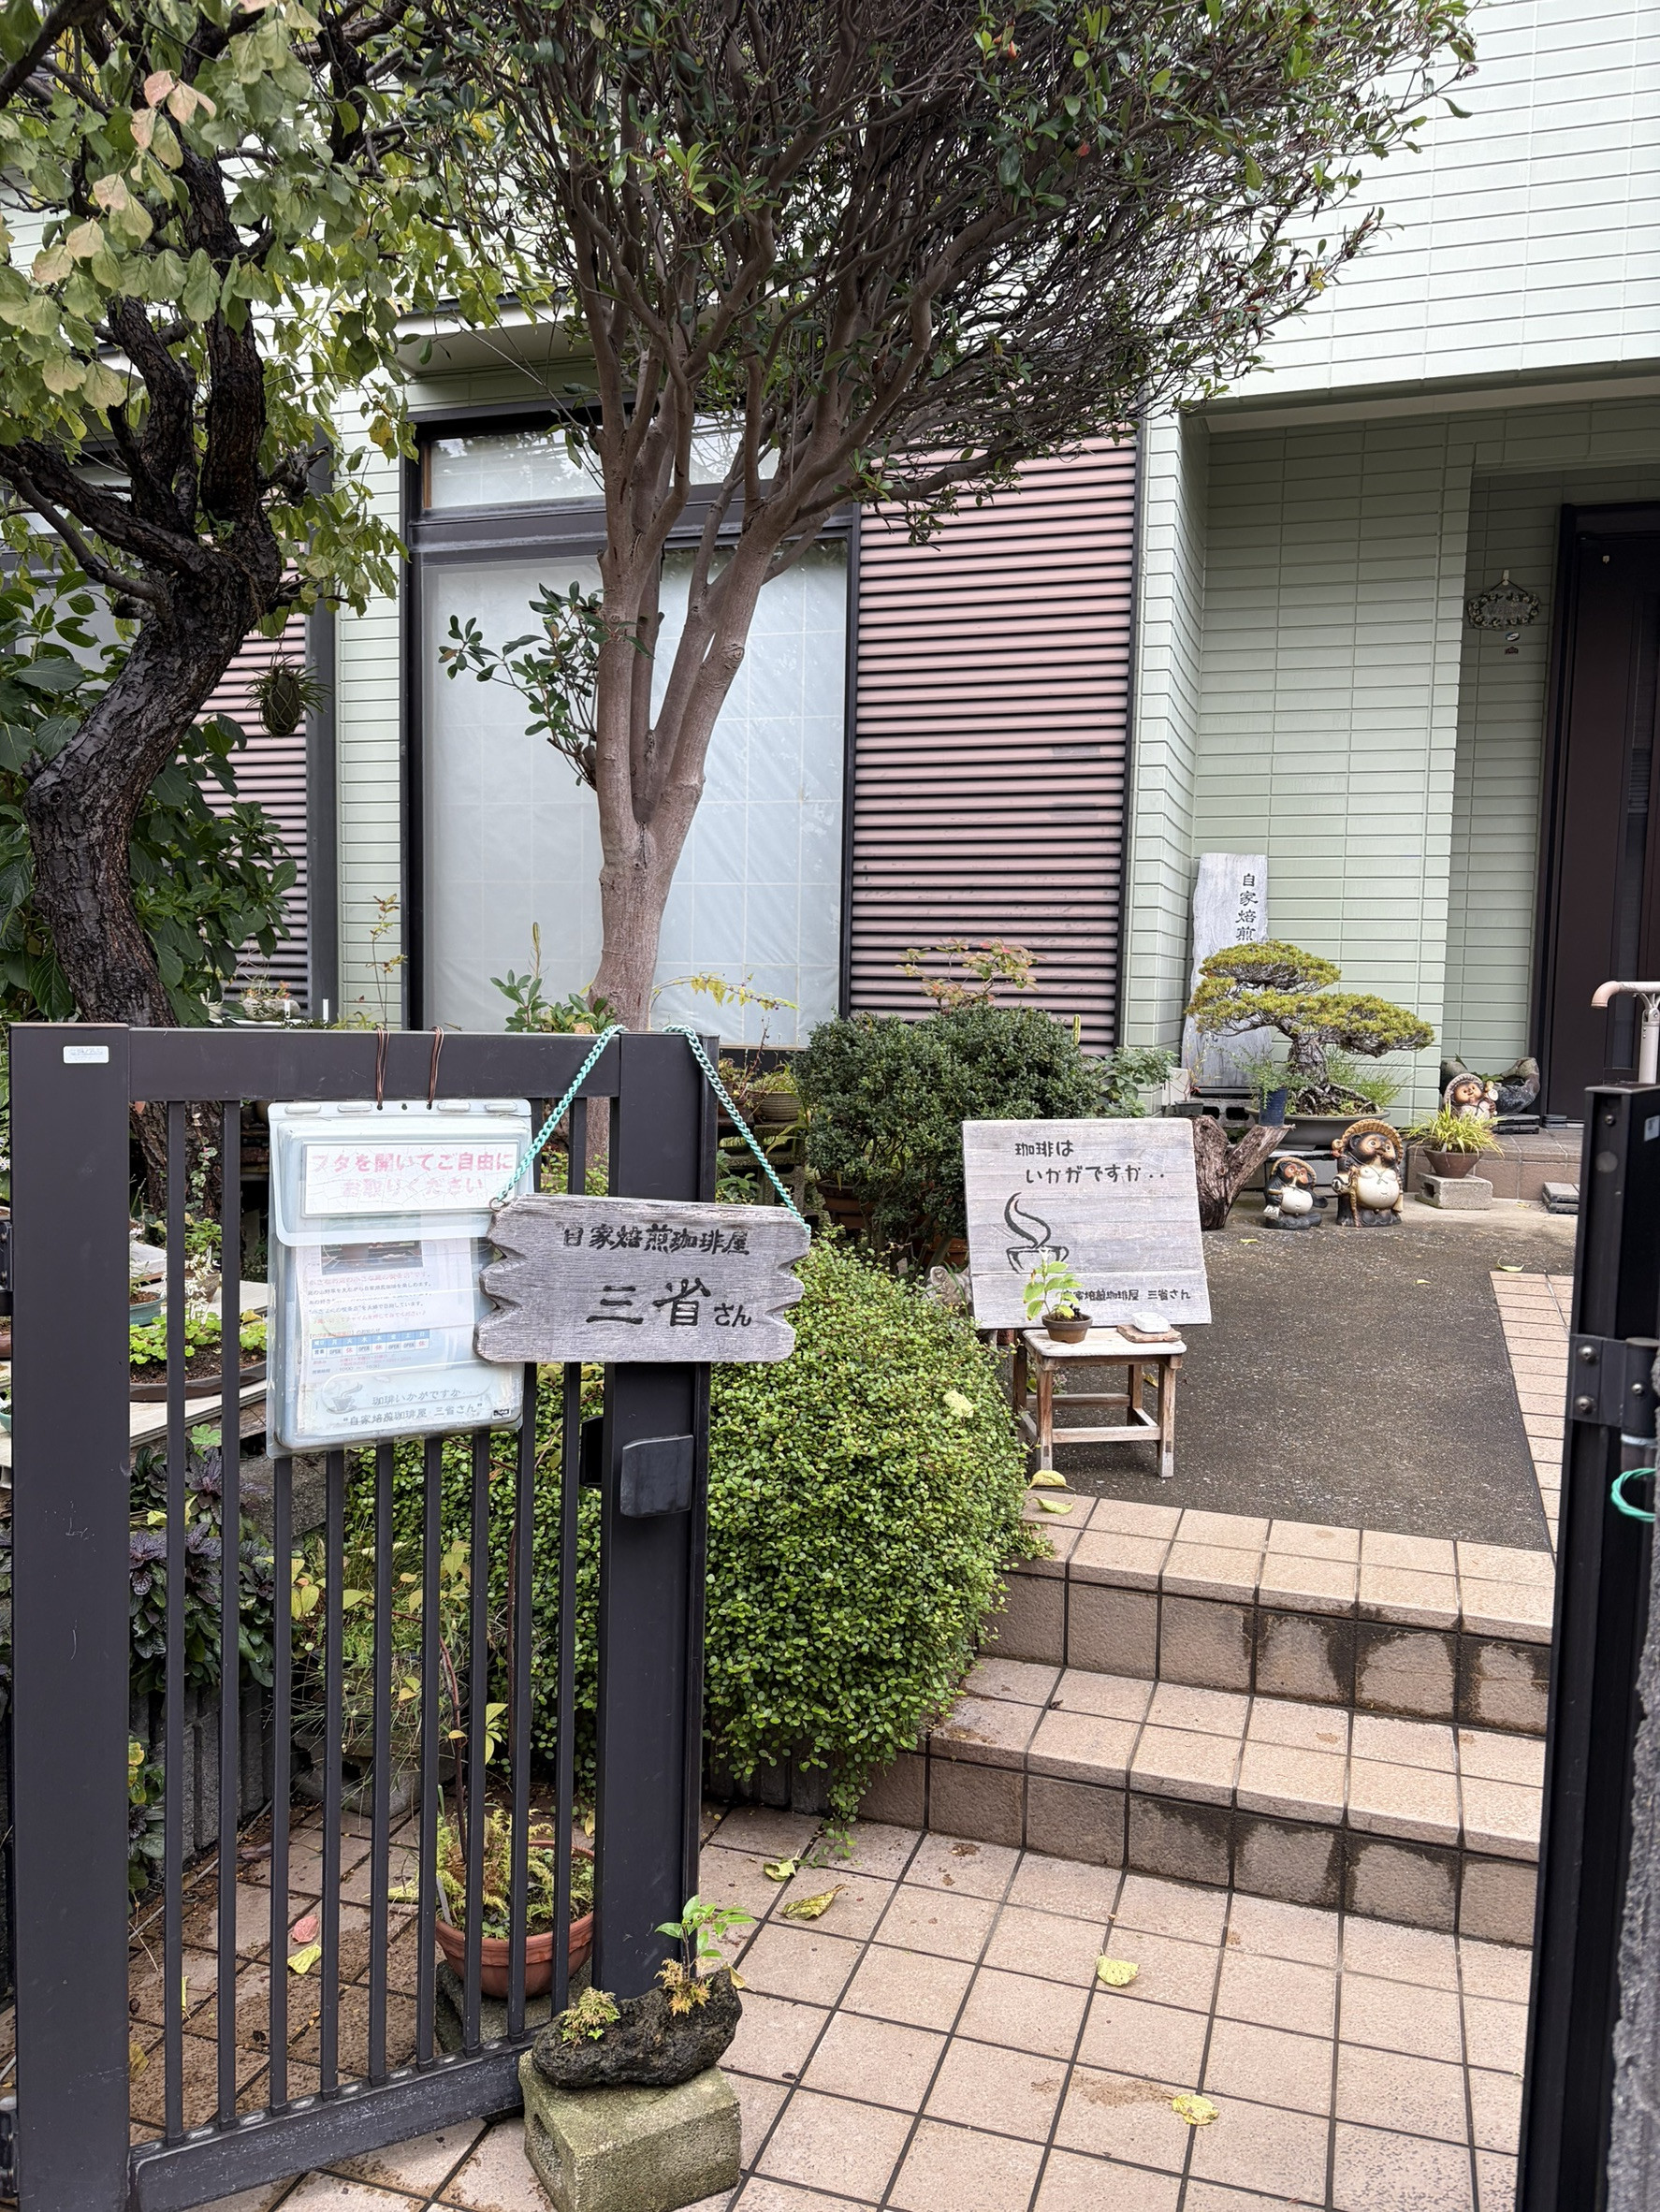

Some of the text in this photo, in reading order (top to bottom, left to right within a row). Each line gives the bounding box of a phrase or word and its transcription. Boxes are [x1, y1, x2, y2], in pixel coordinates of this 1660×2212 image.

[1235, 873, 1259, 941] 自家焙煎
[1014, 1140, 1074, 1157] 珈琲は
[311, 1152, 514, 1173] フタを開いてご自由に
[342, 1177, 483, 1198] お取りください
[562, 1223, 750, 1256] 自家焙煎珈琲屋
[585, 1277, 752, 1327] 三省さん
[1147, 1288, 1191, 1302] 三省さん
